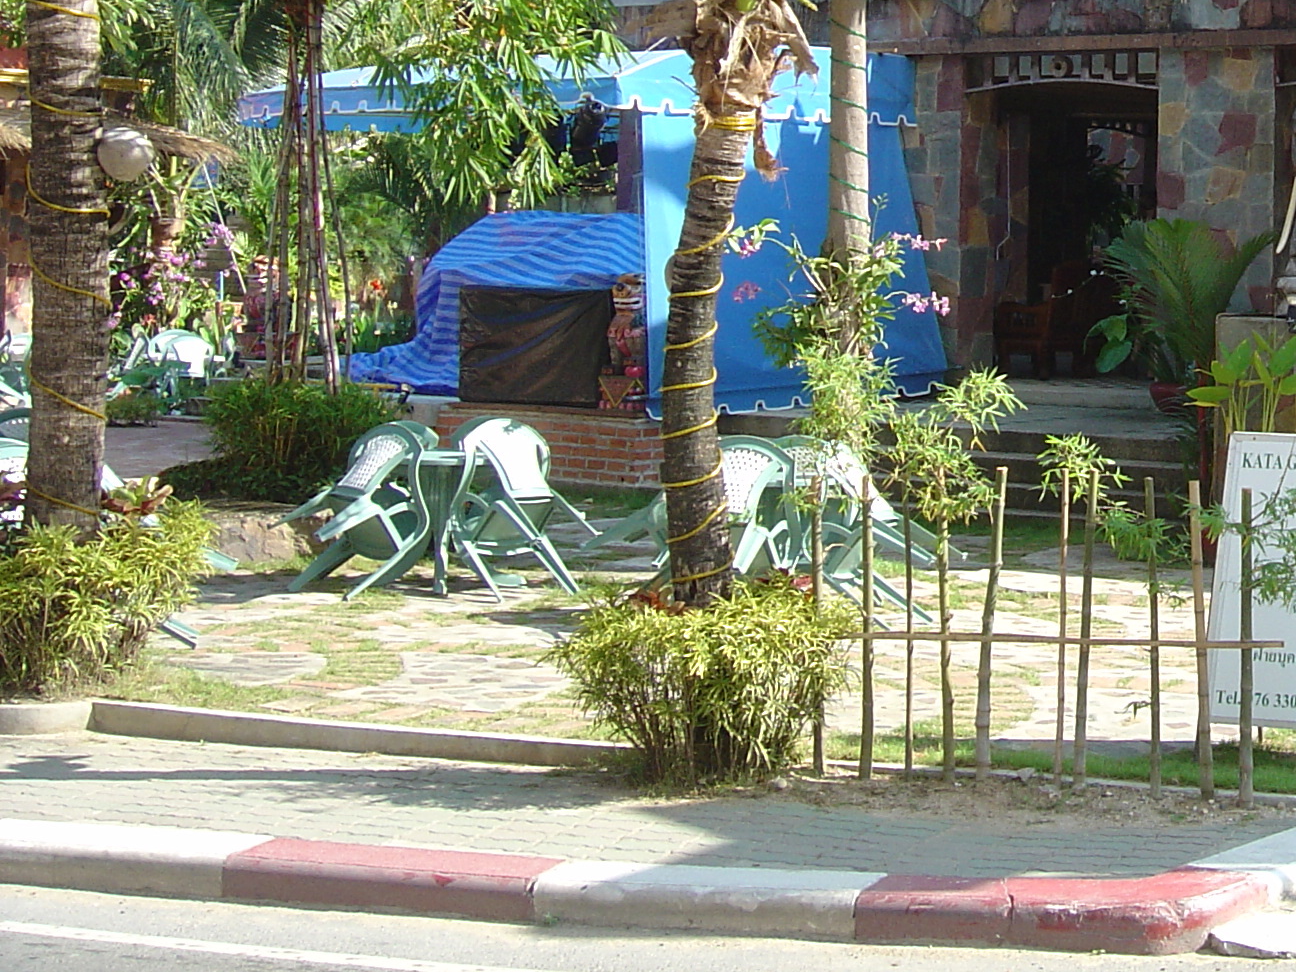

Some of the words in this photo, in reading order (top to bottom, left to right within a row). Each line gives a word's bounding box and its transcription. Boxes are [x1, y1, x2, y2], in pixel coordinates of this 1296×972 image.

[1242, 452, 1283, 469] KATA
[1216, 690, 1242, 706] Tel.
[1248, 692, 1270, 707] 76
